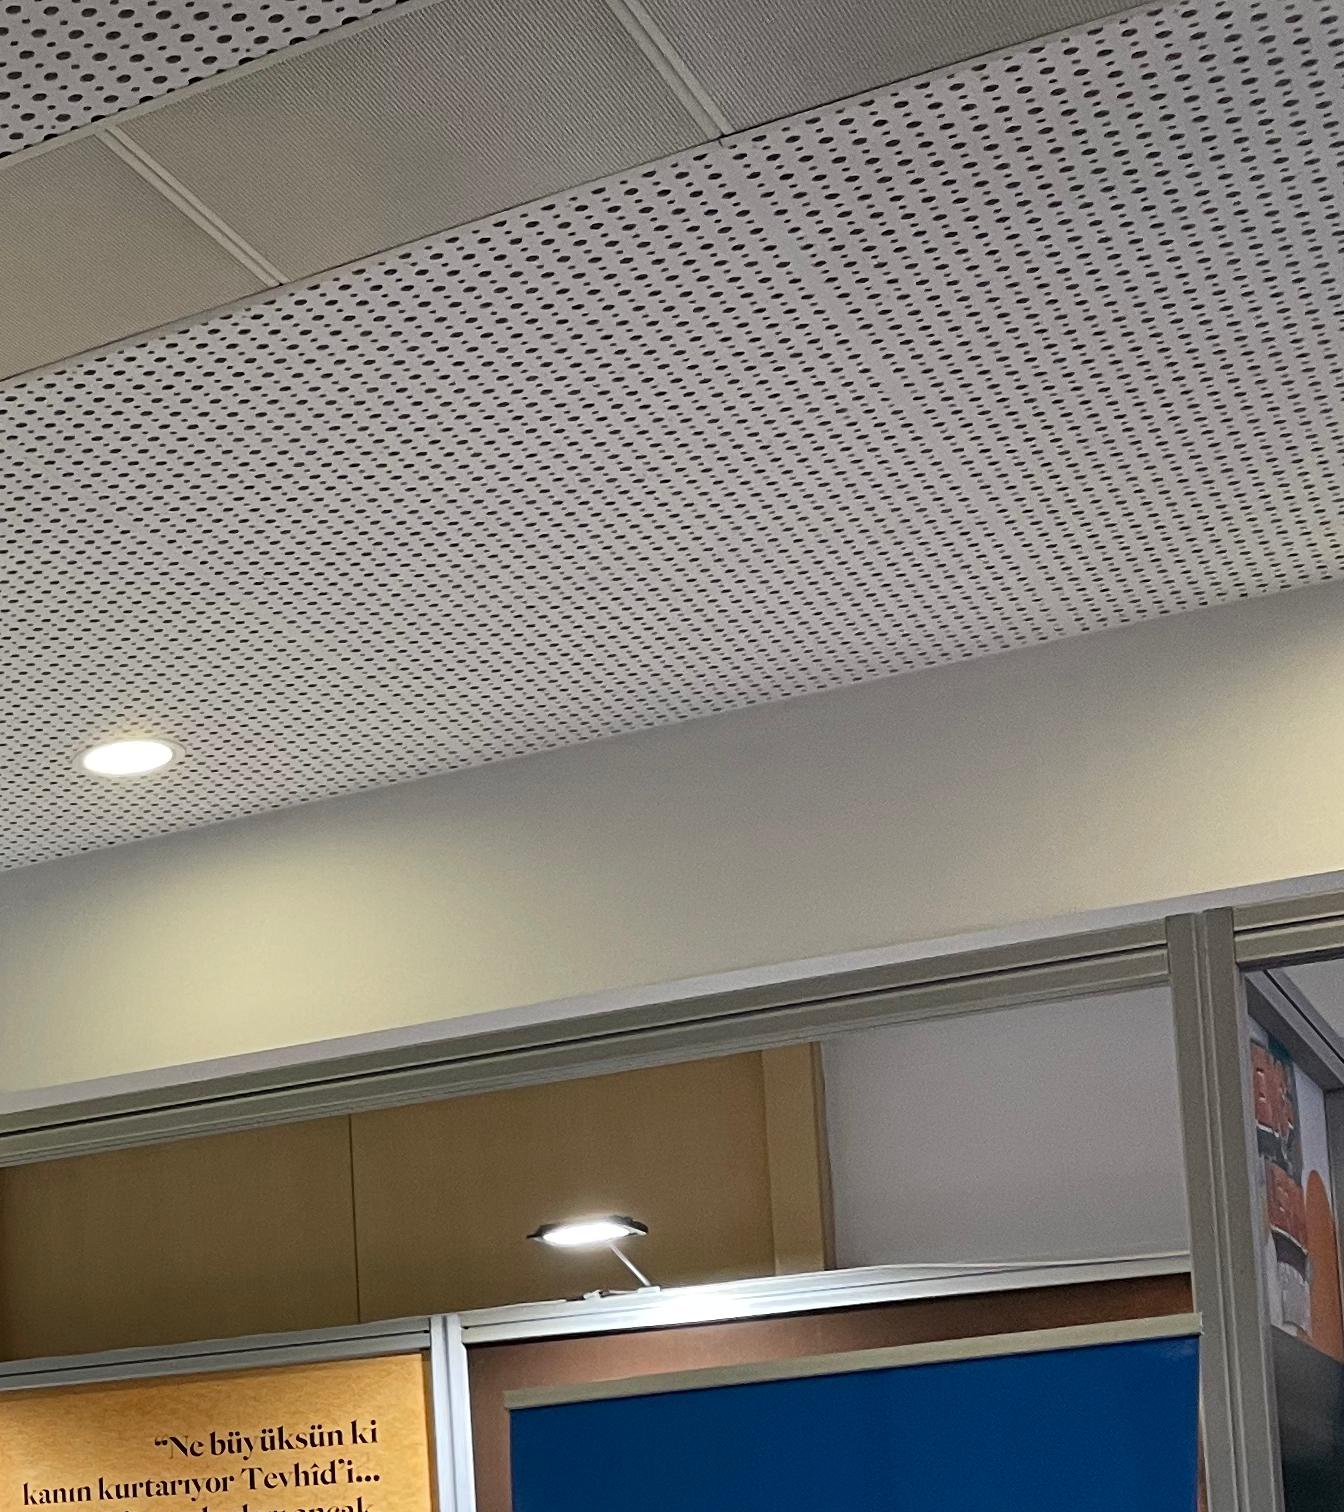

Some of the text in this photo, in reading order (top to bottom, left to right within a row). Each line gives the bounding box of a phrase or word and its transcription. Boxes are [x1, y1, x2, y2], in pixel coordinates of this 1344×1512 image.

[154, 1419, 379, 1461] “Ne büyüksün ki
[23, 1482, 92, 1506] kanın
[98, 1475, 235, 1502] kurtarıyor
